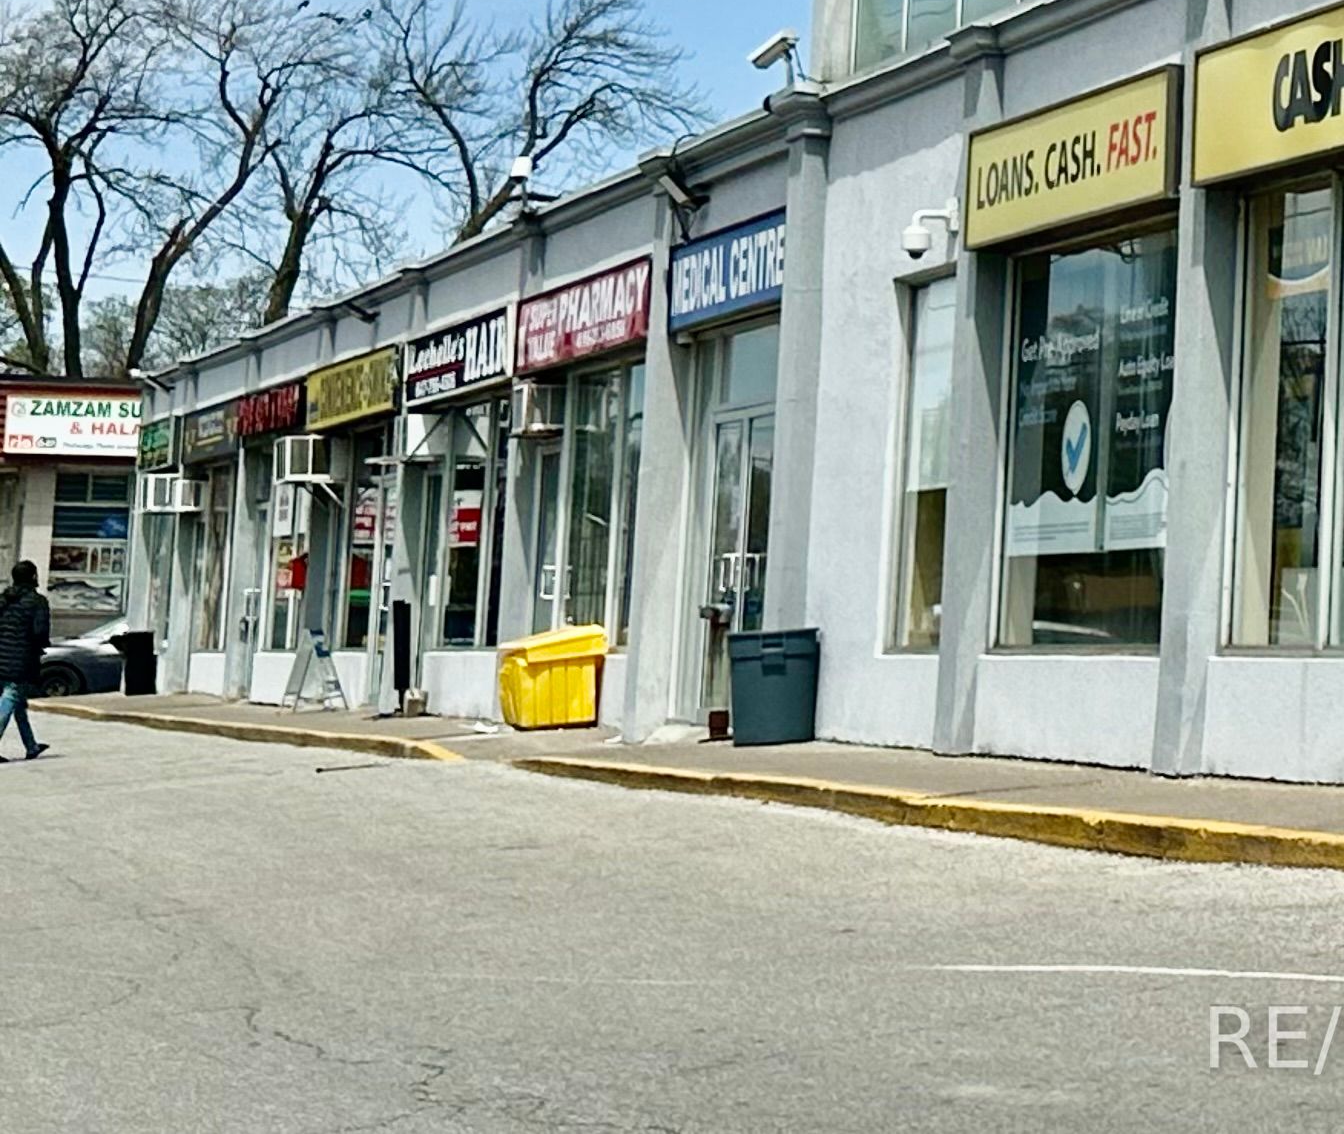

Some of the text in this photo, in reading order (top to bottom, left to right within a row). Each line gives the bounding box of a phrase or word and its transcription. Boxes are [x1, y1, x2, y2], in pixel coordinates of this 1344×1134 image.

[976, 111, 1158, 210] LOANS. CASH. FAST.
[559, 265, 650, 332] PHARMACY
[672, 224, 785, 317] MEDICAL CENTRE
[463, 315, 508, 382] HAIR
[30, 399, 112, 417] ZAMZAM
[69, 421, 83, 435] &
